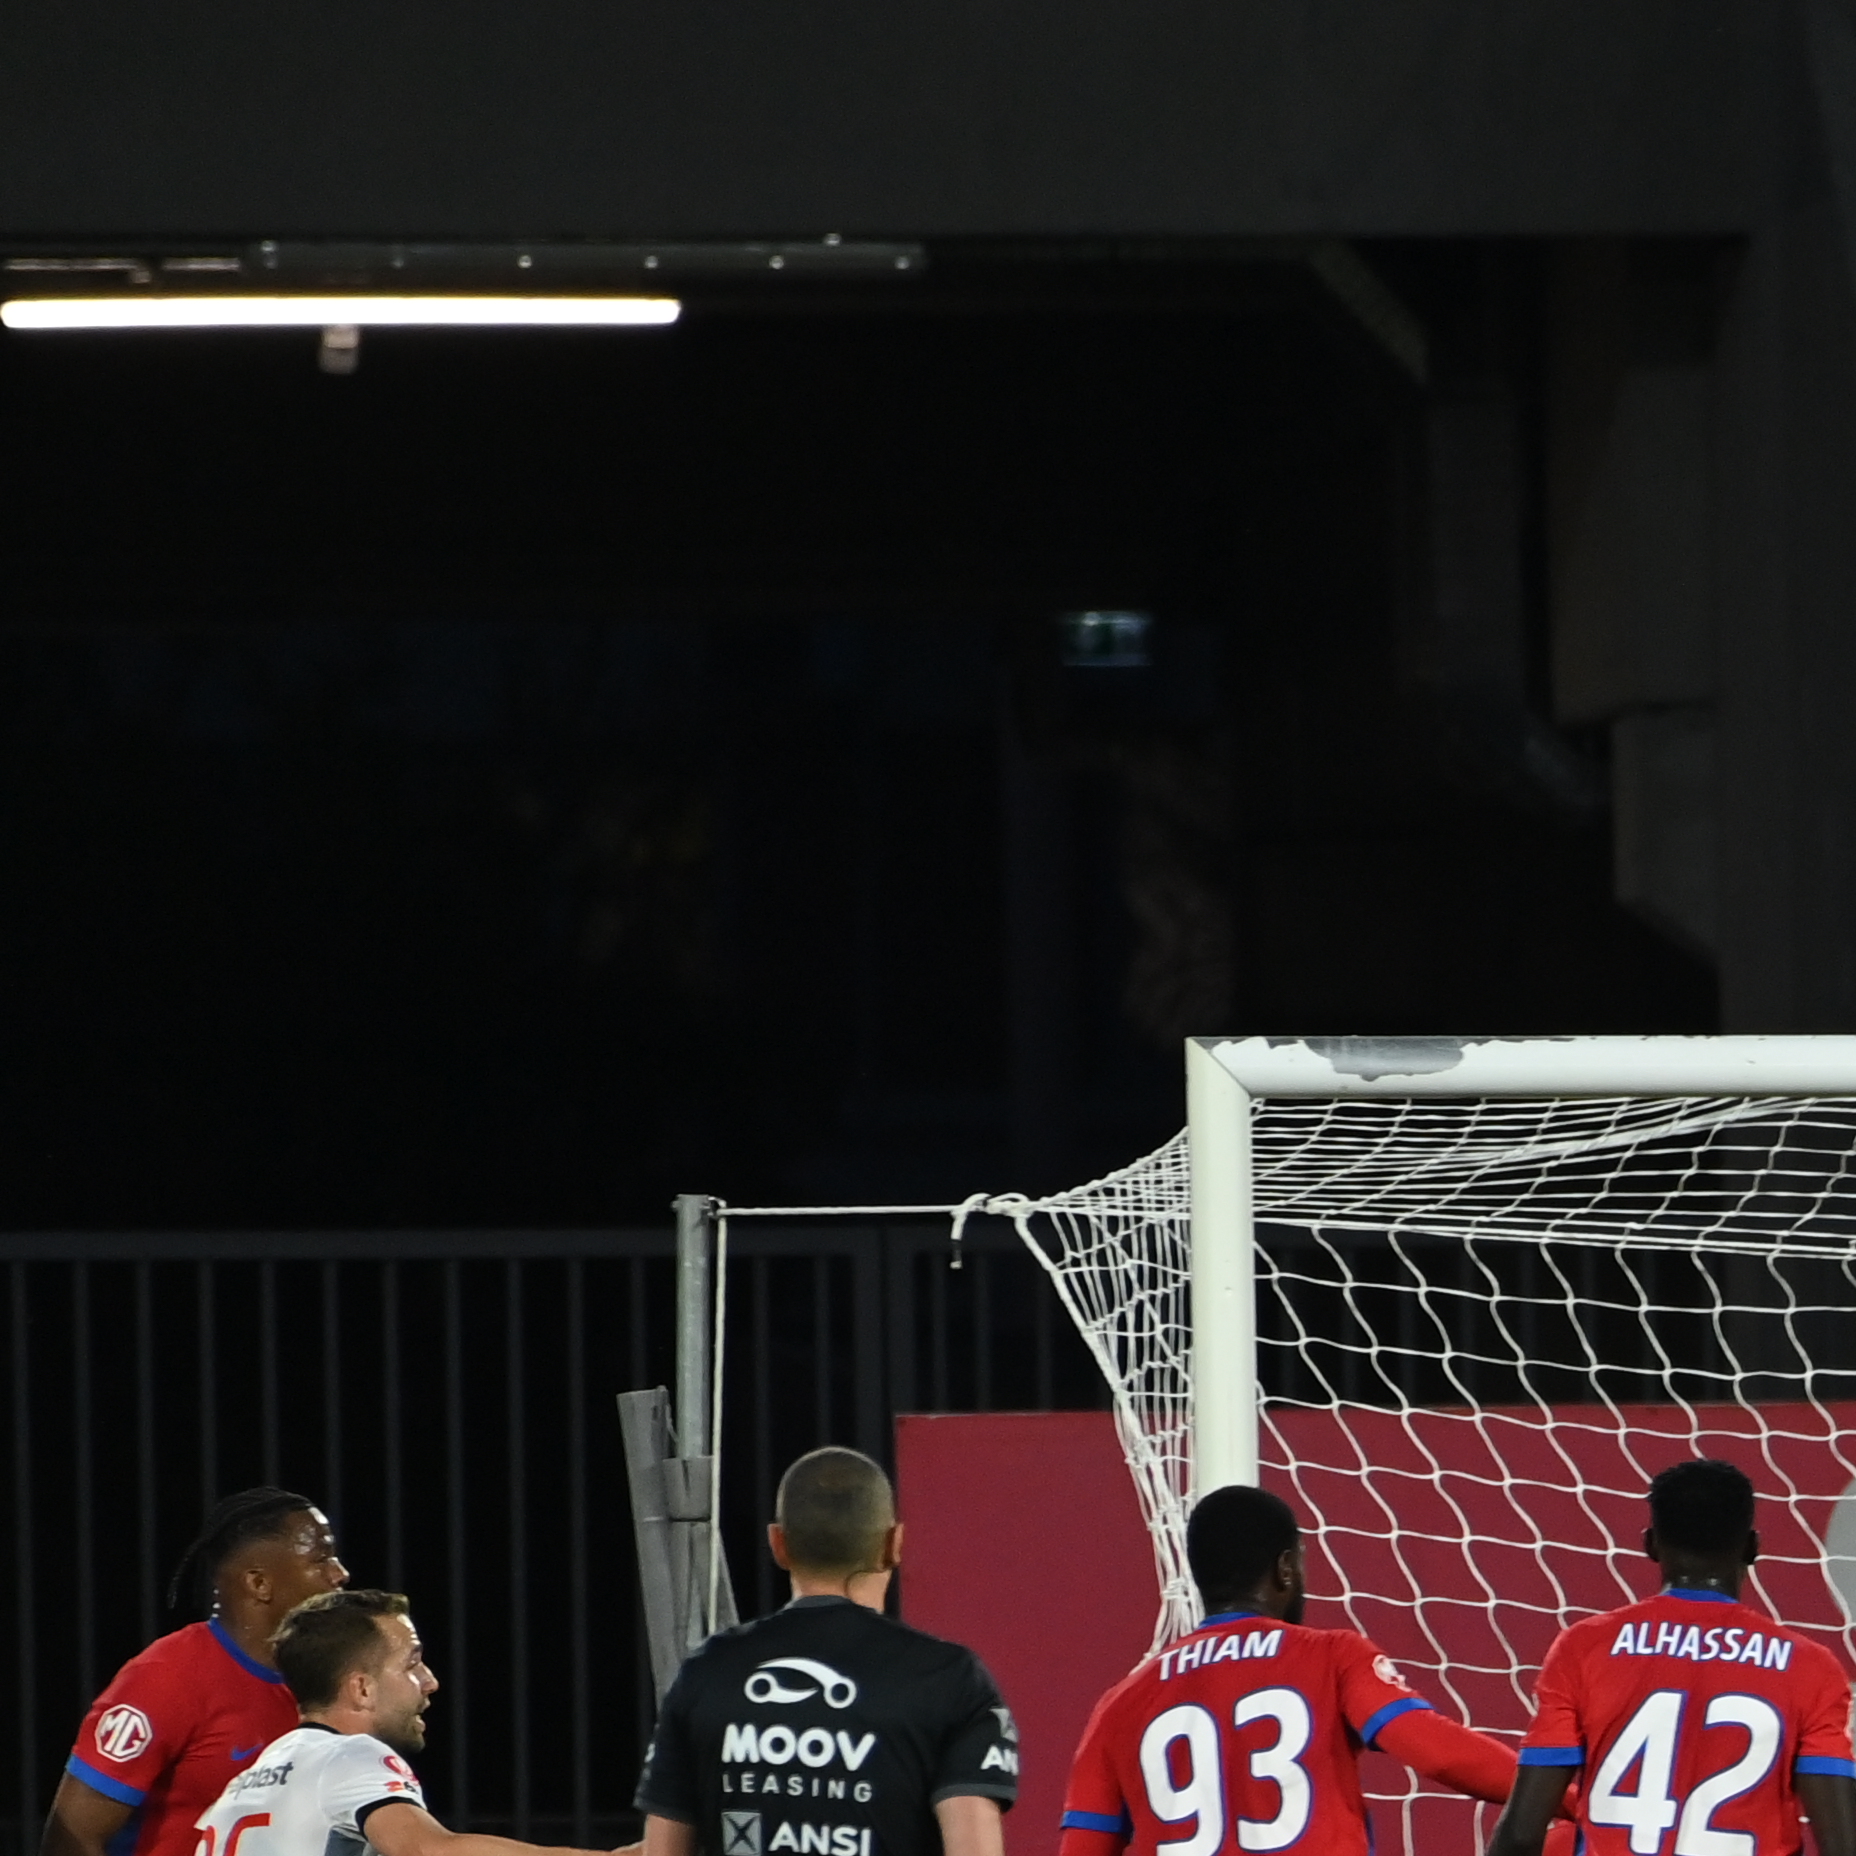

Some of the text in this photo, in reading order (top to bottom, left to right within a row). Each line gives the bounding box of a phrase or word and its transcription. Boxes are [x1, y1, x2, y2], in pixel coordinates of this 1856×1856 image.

[1158, 1629, 1284, 1681] THIAM
[1610, 1621, 1793, 1672] ALHASSAN
[721, 1722, 876, 1772] MOOV
[980, 1744, 1019, 1776] AN
[722, 1773, 873, 1803] LEASING
